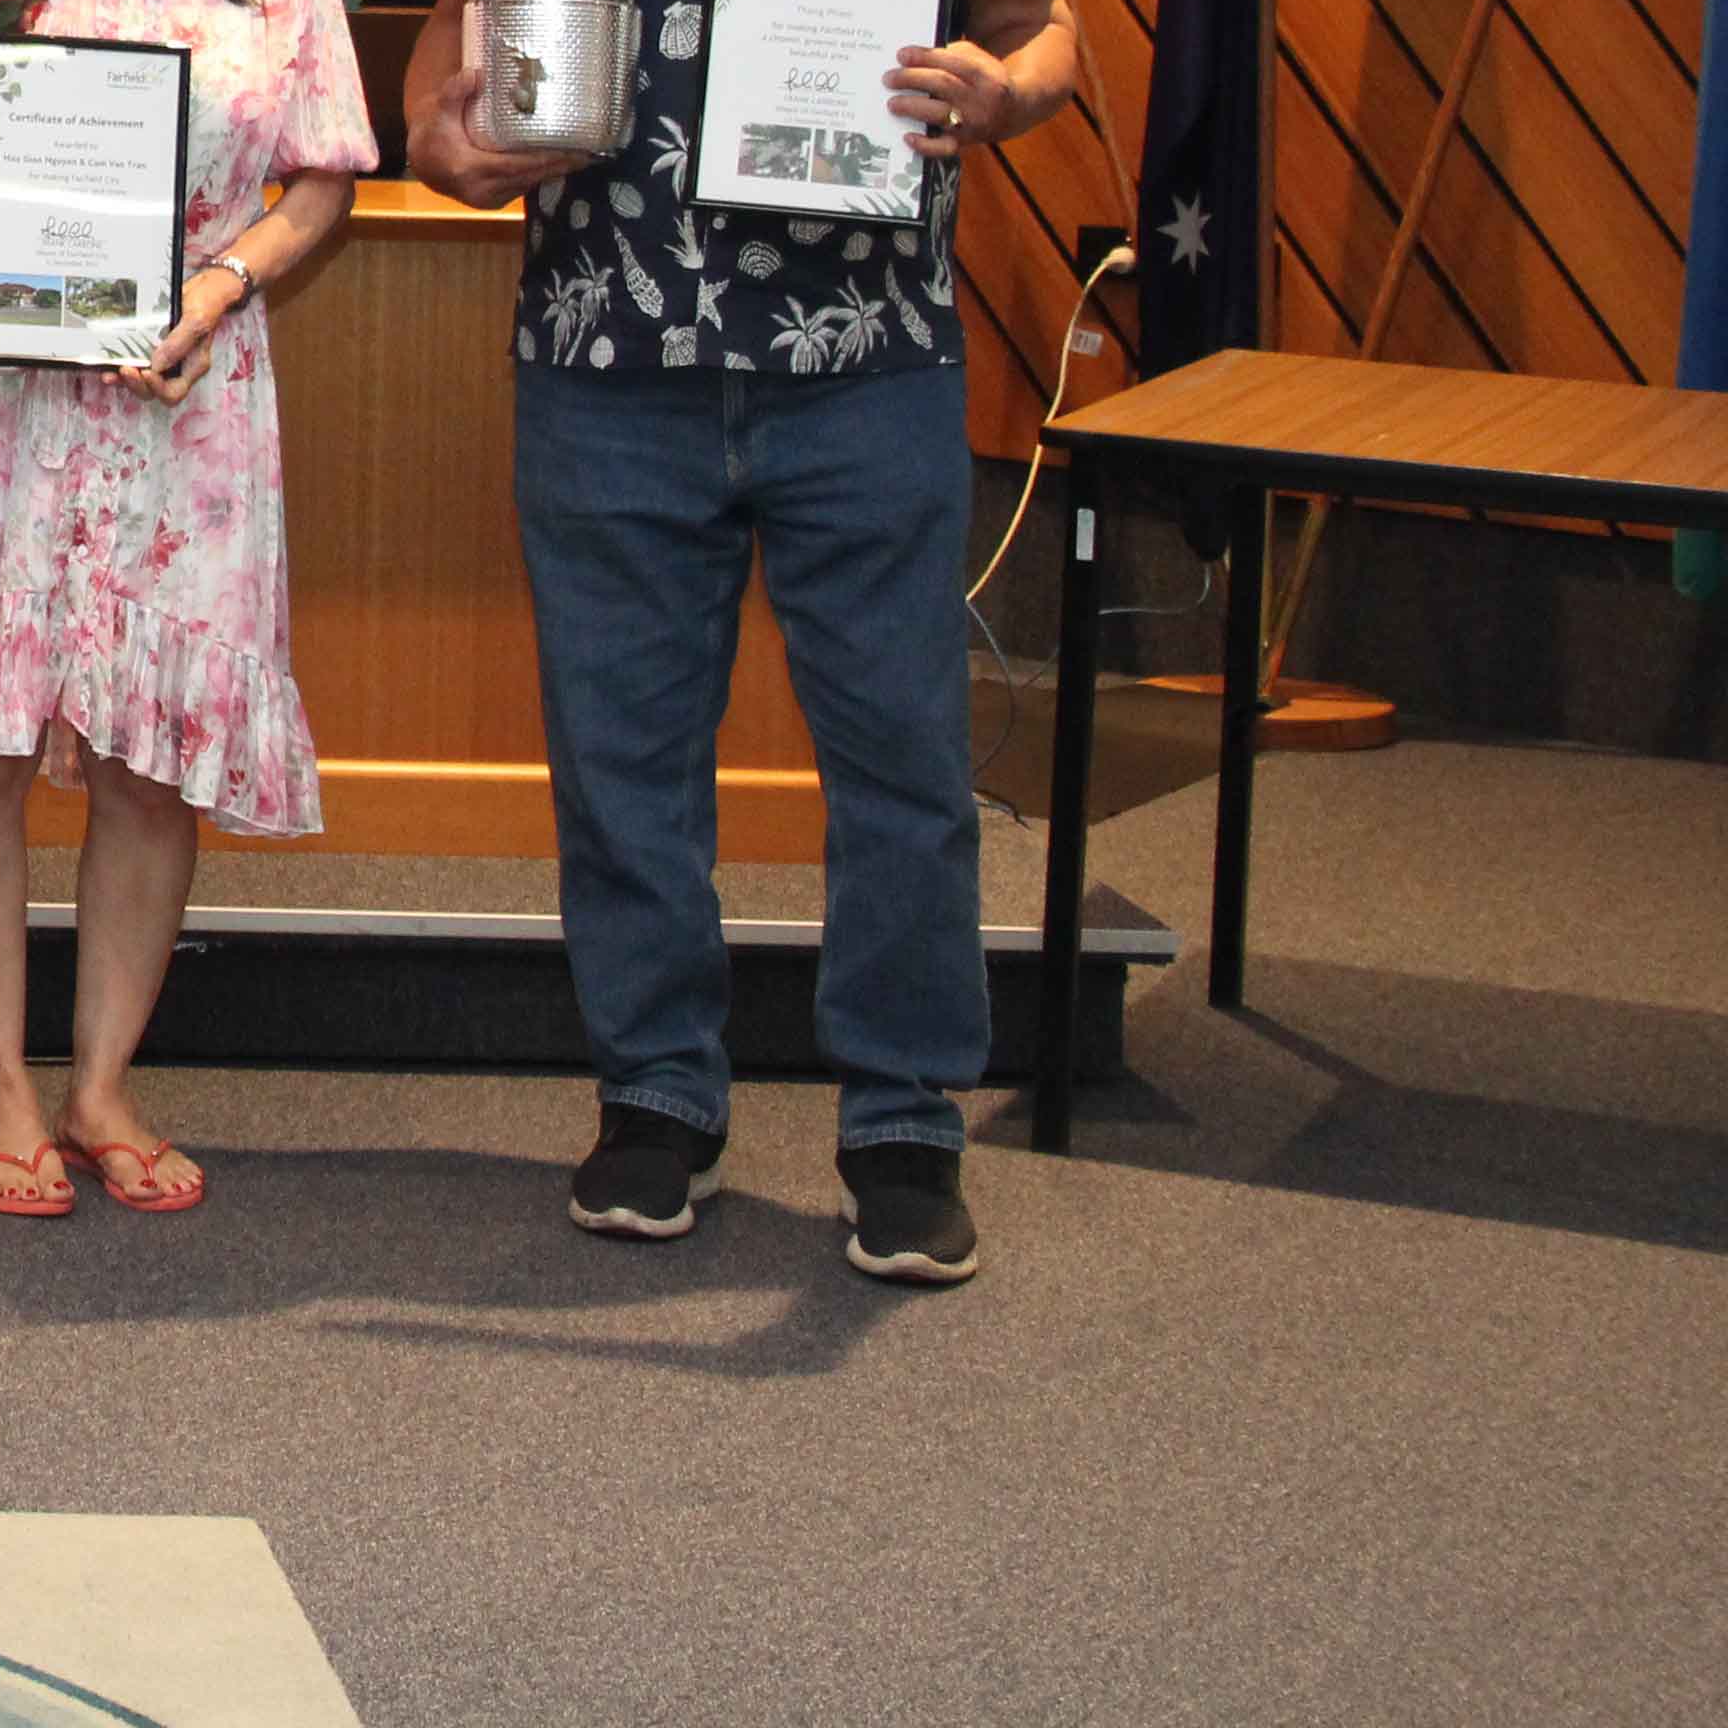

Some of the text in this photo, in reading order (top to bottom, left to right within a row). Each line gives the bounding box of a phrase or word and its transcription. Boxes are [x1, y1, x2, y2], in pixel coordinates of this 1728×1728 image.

[8, 112, 144, 129] Certificate of Achievement
